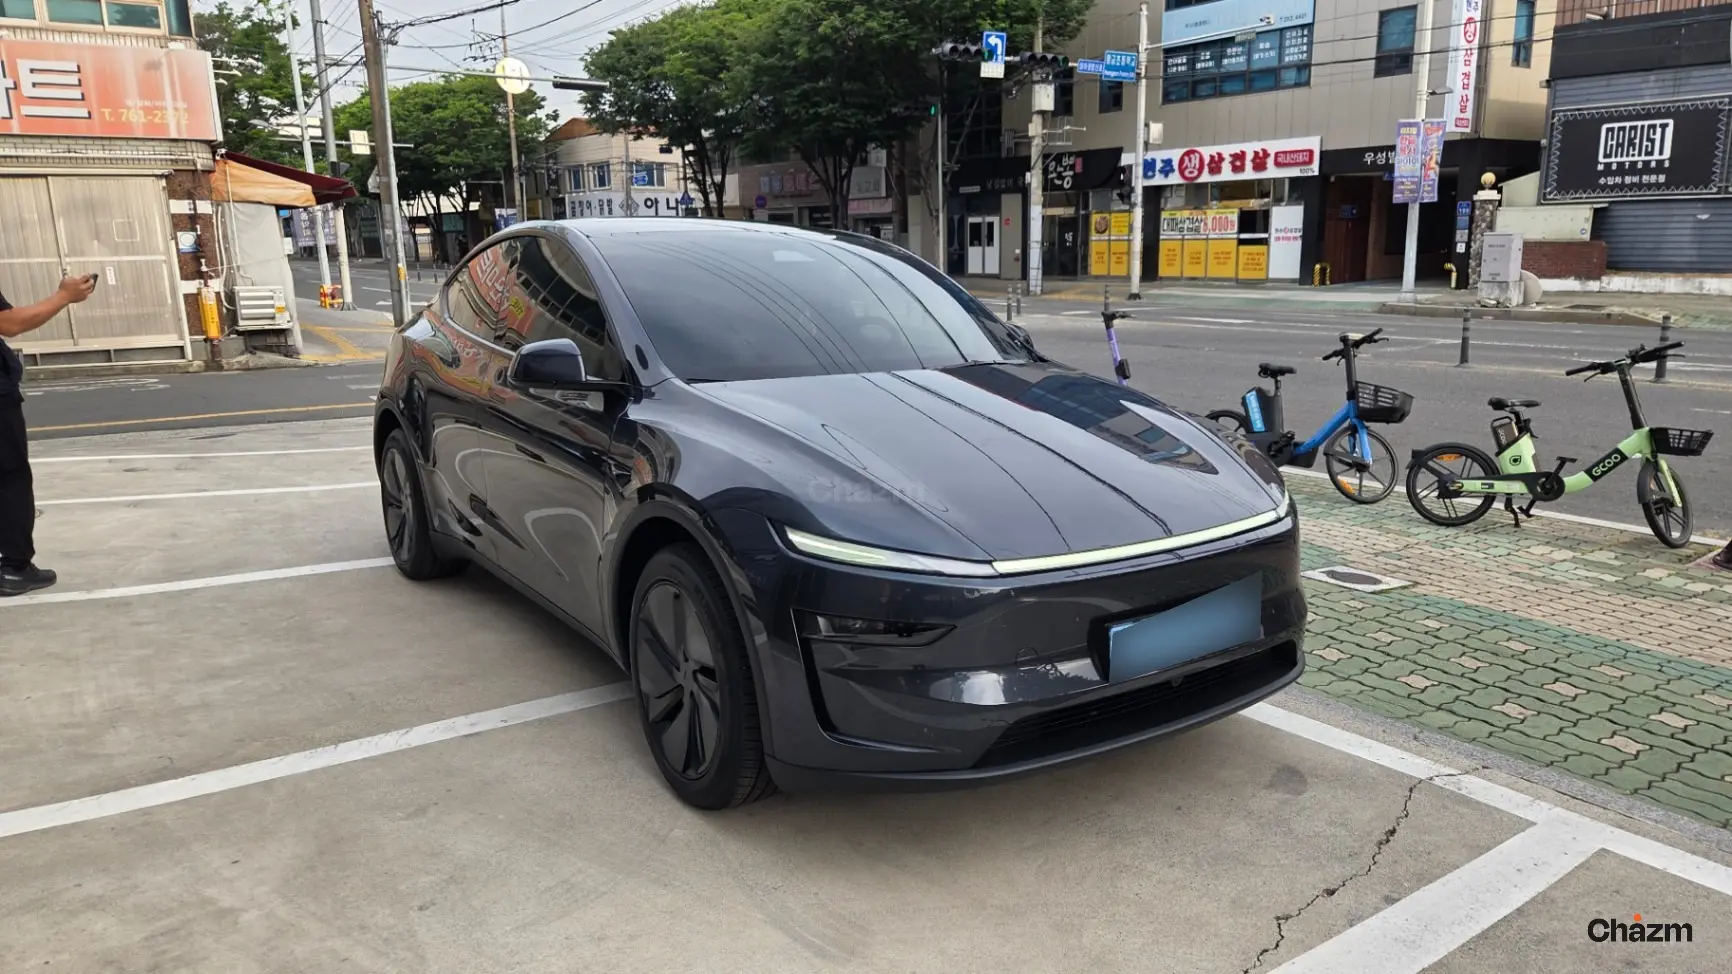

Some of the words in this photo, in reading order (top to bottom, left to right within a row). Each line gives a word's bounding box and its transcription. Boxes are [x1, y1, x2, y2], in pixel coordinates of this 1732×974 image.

[1459, 48, 1473, 114] 삼겹살
[1602, 122, 1670, 159] CARIST
[1181, 152, 1200, 178] 생
[1206, 148, 1270, 176] 삼겹살
[1277, 151, 1310, 164] 국내산돼지
[1299, 167, 1315, 175] 100%
[1597, 160, 1670, 171] MOTORS
[1598, 175, 1622, 185] 수입차
[1624, 175, 1640, 184] 정비
[1642, 174, 1666, 184] 전문점
[1592, 454, 1621, 476] GCOO
